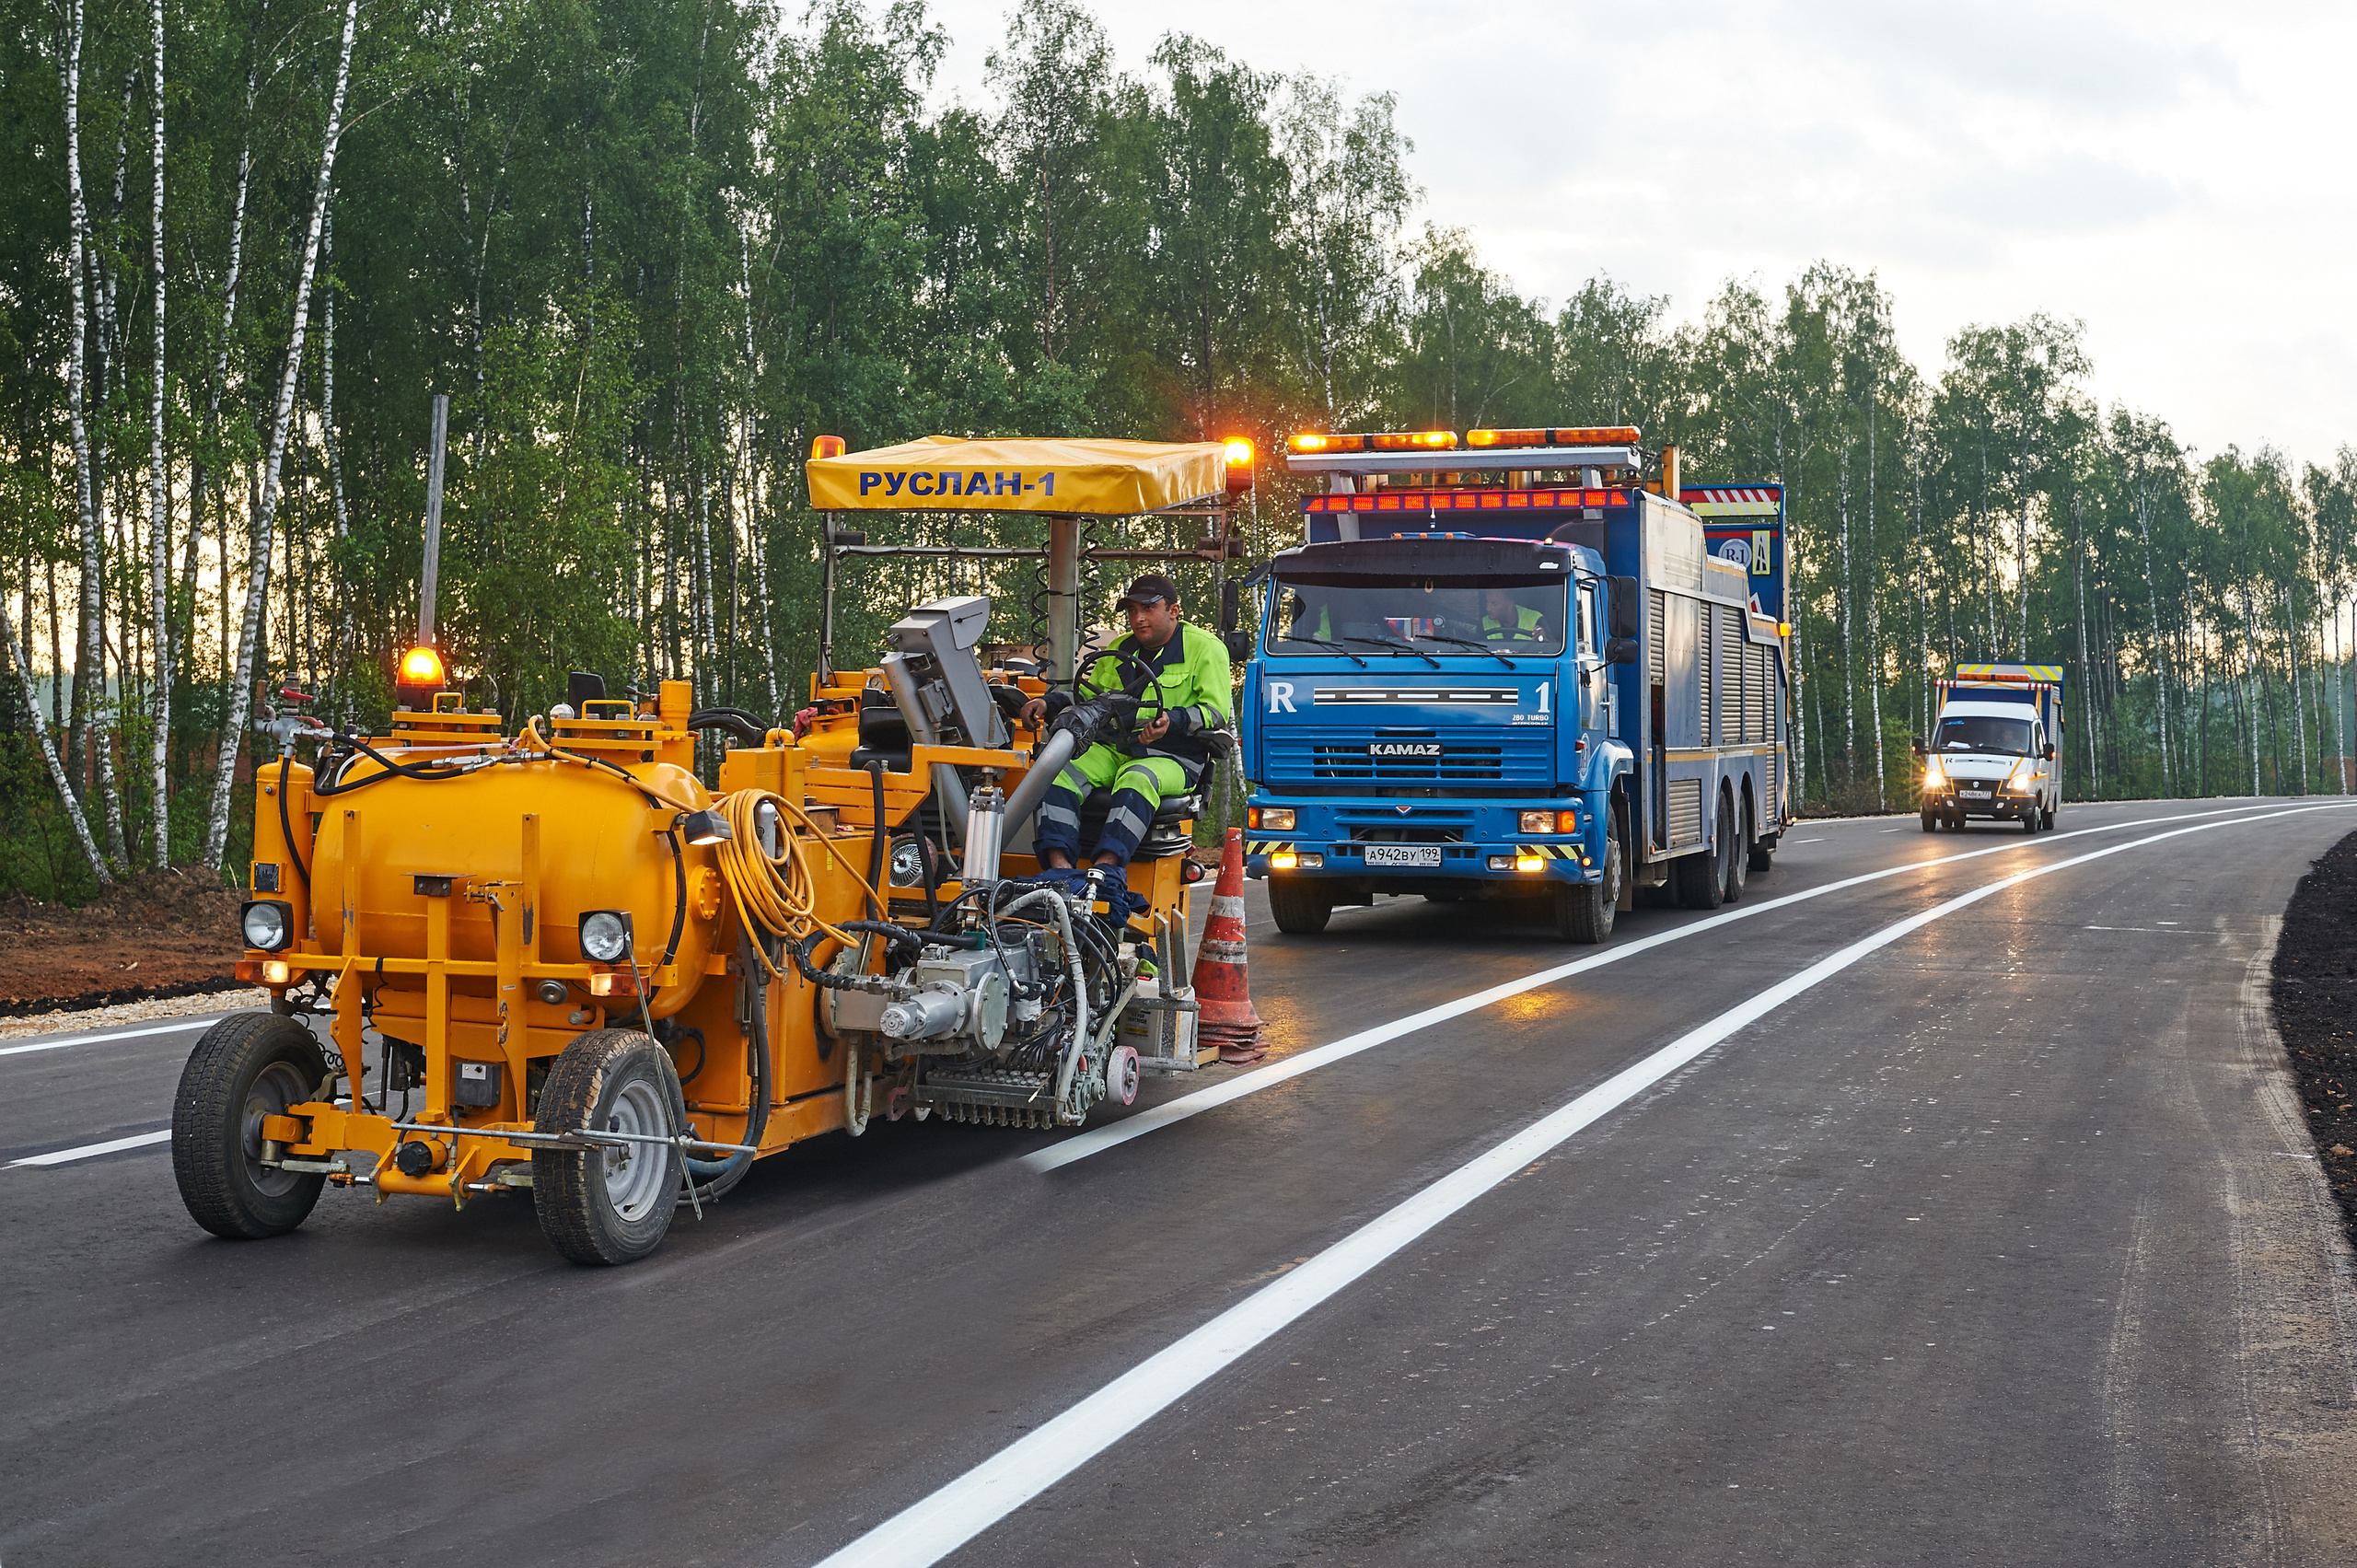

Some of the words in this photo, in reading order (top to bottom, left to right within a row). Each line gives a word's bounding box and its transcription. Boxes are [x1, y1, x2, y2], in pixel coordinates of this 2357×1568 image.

[859, 471, 1055, 497] РУСЛАН-1
[1269, 682, 1297, 713] R
[1535, 681, 1550, 713] 1
[1527, 714, 1550, 722] TURBO
[1370, 744, 1440, 756] KAMAZ
[1420, 848, 1438, 858] 199
